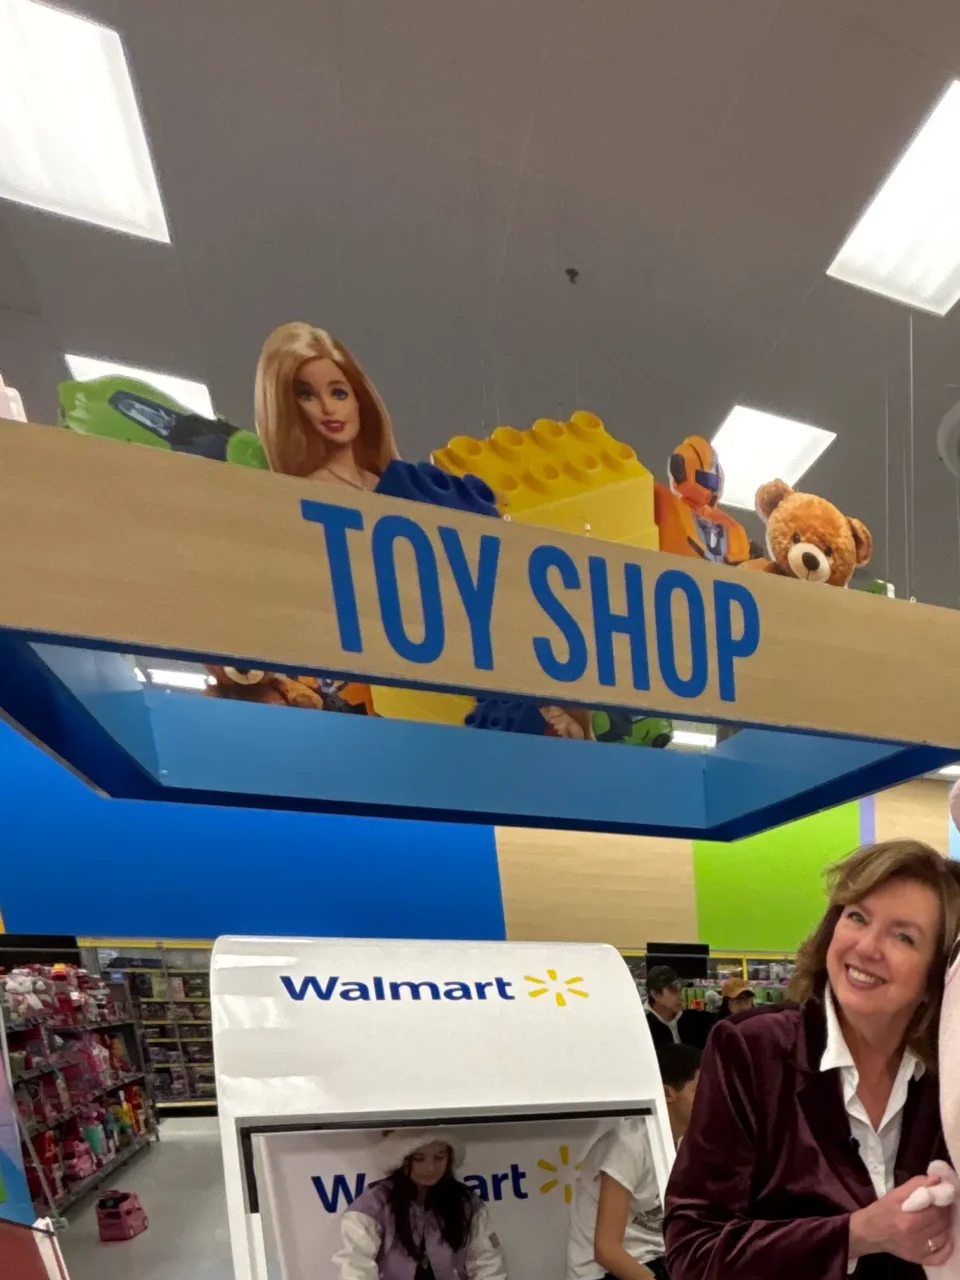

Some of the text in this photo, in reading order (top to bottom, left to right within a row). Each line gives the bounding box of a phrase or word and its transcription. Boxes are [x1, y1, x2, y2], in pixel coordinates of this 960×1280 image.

[301, 498, 760, 702] TOY SHOP
[279, 975, 515, 1001] Walmart
[312, 1163, 528, 1213] Wart
